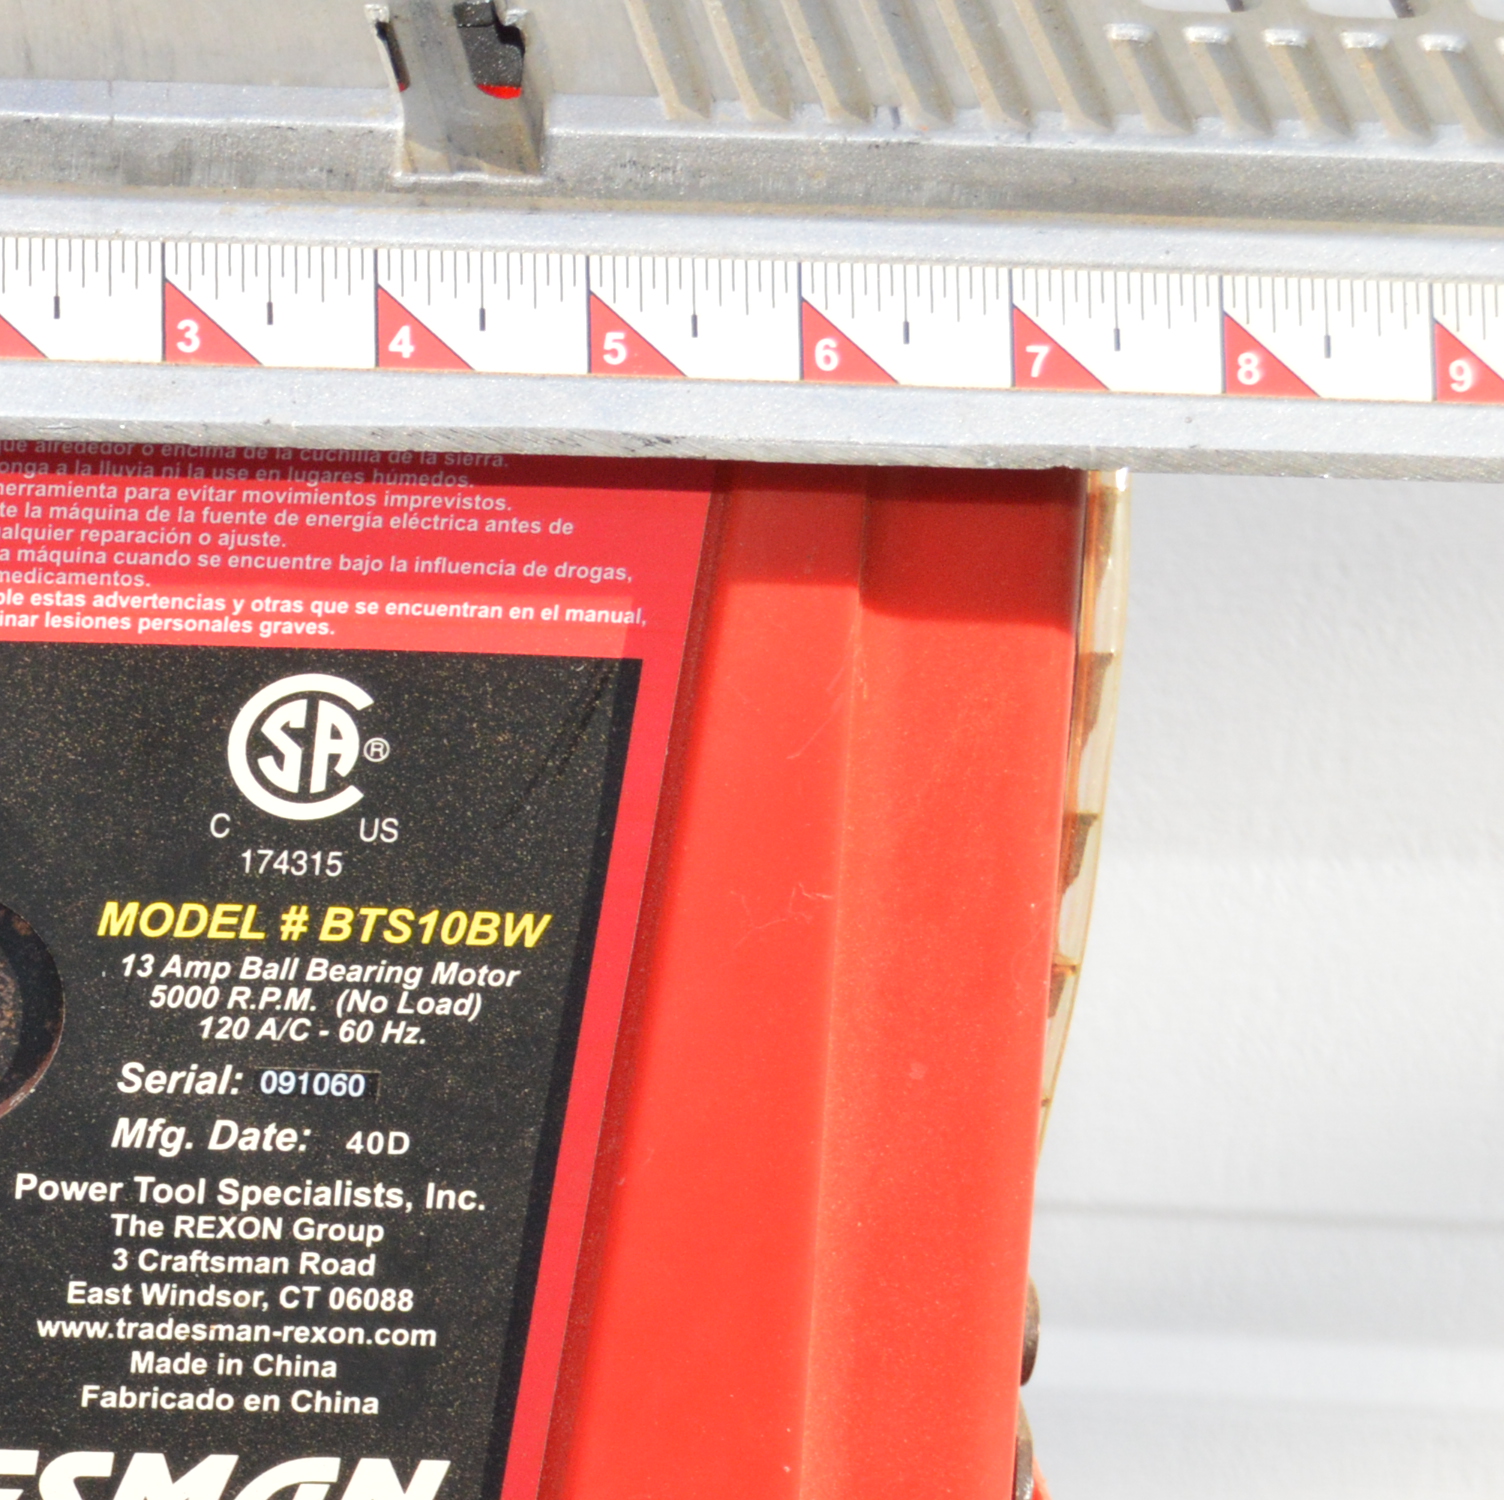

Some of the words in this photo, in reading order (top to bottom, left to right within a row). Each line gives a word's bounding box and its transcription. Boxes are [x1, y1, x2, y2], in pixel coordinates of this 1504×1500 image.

[176, 319, 201, 353] 3
[388, 325, 415, 359] 4
[603, 331, 628, 365] 5
[814, 337, 840, 371] 6
[1026, 344, 1052, 378] 7
[1237, 350, 1264, 385] 8
[1449, 359, 1474, 391] 9
[125, 486, 170, 503] para
[177, 485, 236, 503] evitar
[242, 487, 376, 507] movimientos
[384, 490, 511, 512] imprevistos.
[45, 611, 131, 630] lesiones
[138, 615, 252, 635] personales
[260, 620, 334, 638] graves.
[360, 818, 398, 842] US
[242, 849, 342, 877] 174315
[97, 901, 265, 940] MODEL
[280, 905, 309, 941] #
[319, 906, 551, 948] BTS10BW
[122, 953, 154, 977] 13
[160, 954, 231, 985] Amp
[239, 956, 299, 981] Ball
[306, 957, 423, 991] Bearing
[431, 961, 521, 987] Motor
[150, 984, 220, 1009] 5000
[227, 986, 316, 1011] R.P.M.
[336, 988, 388, 1018] (No
[397, 991, 481, 1022] Load)
[200, 1015, 250, 1041] 120
[255, 1017, 311, 1042] A/C
[339, 1019, 374, 1043] 60
[381, 1020, 425, 1044] Hz.
[117, 1062, 243, 1095] Serial:
[261, 1070, 365, 1097] 091060
[111, 1117, 193, 1158] Mfg.
[208, 1119, 311, 1152] Date:
[346, 1130, 409, 1155] 40D
[15, 1173, 123, 1203] Power
[134, 1175, 205, 1205] Tool
[217, 1177, 412, 1214] Specialists,
[426, 1182, 485, 1211] Inc.
[111, 1213, 164, 1237] The
[174, 1215, 282, 1240] REXON
[293, 1217, 384, 1248] Group
[112, 1248, 128, 1271] 3
[138, 1248, 289, 1275] Craftsman
[300, 1251, 375, 1276] Road
[67, 1281, 132, 1306] East
[141, 1282, 268, 1311] Windsor,
[280, 1285, 321, 1309] CT
[329, 1287, 413, 1312] 06088
[37, 1317, 436, 1346] www.tradesman-rexon.com
[130, 1351, 207, 1375] Made
[218, 1352, 243, 1376] in
[253, 1353, 336, 1378] China
[81, 1385, 234, 1411] Fabricado
[244, 1393, 280, 1412] en
[291, 1390, 378, 1415] China
